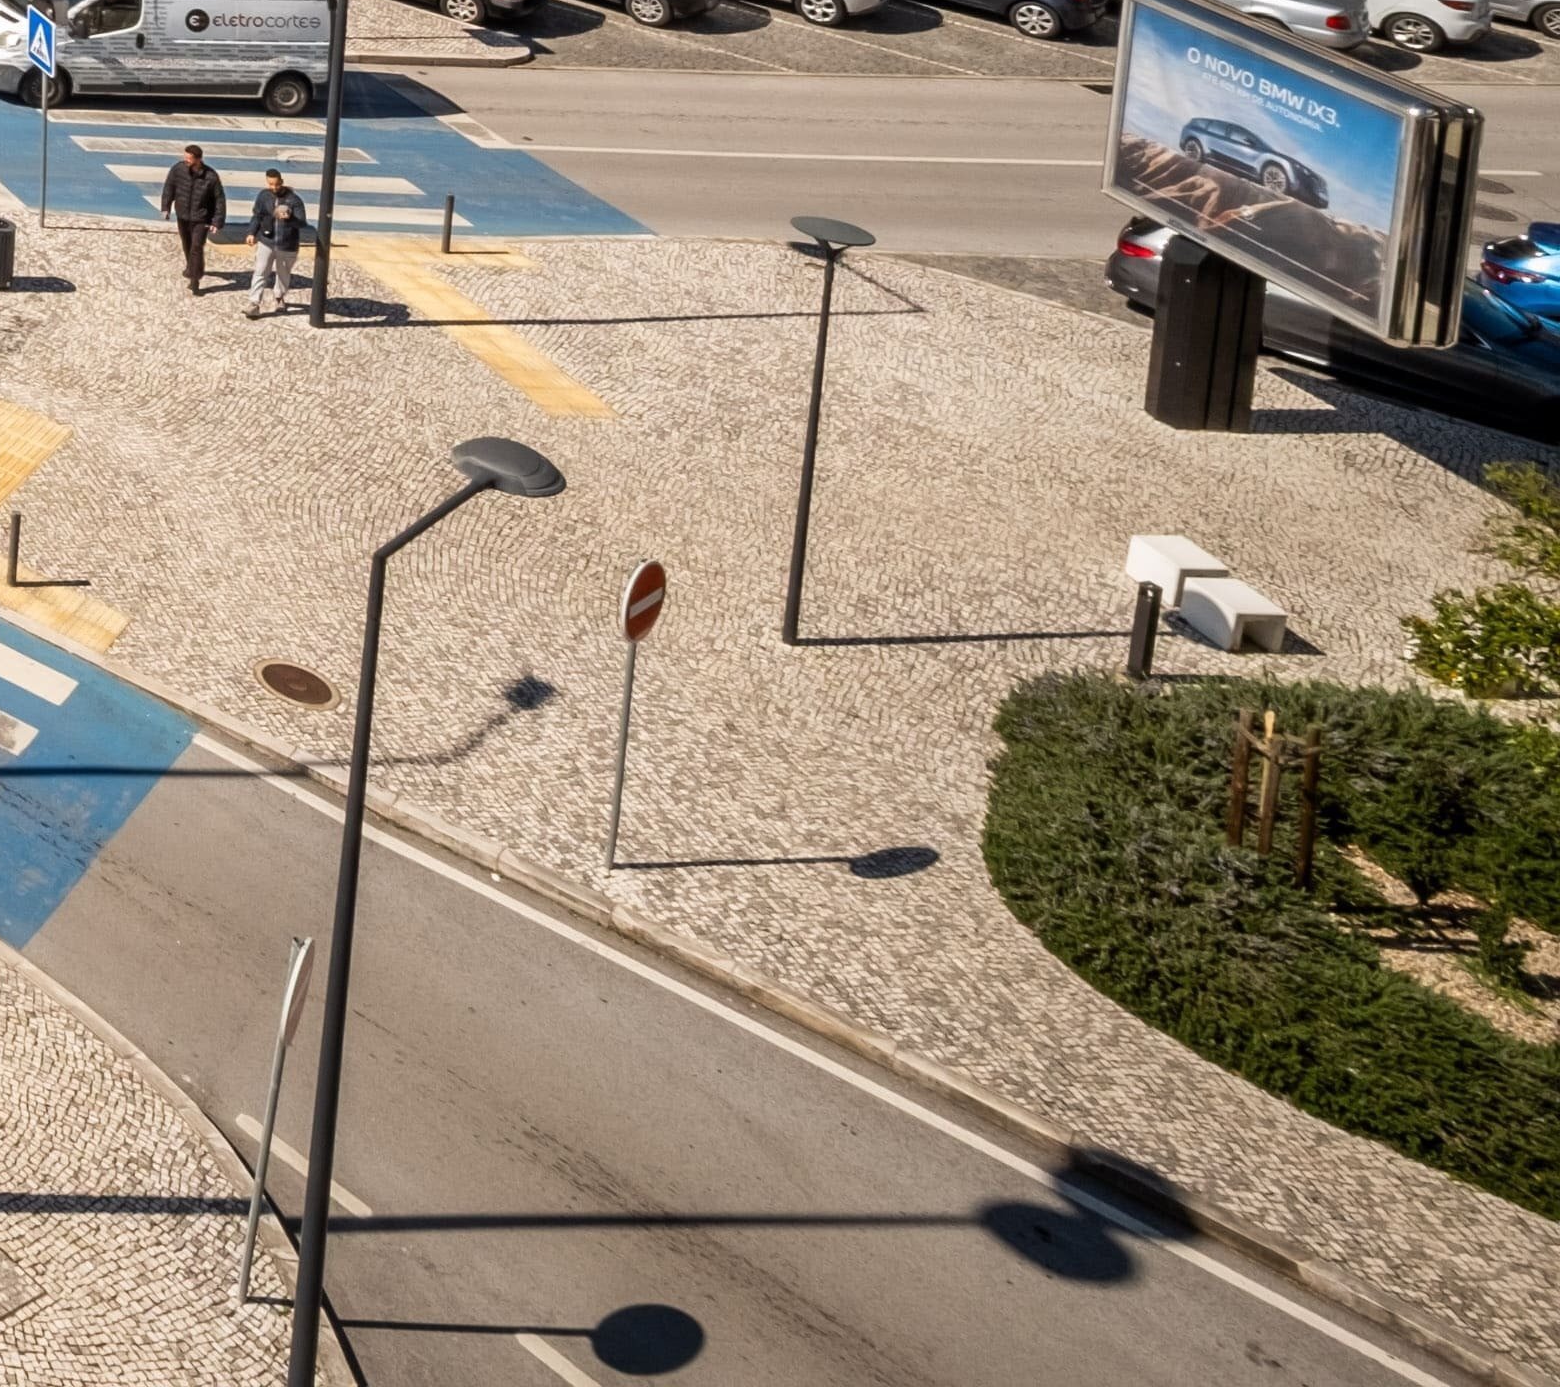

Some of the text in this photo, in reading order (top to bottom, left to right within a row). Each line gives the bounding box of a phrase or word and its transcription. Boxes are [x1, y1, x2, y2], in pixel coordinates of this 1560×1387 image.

[212, 13, 321, 29] eletrocortes
[1187, 47, 1201, 64] O
[1205, 54, 1255, 88] NOVO
[1259, 78, 1305, 110] BMW
